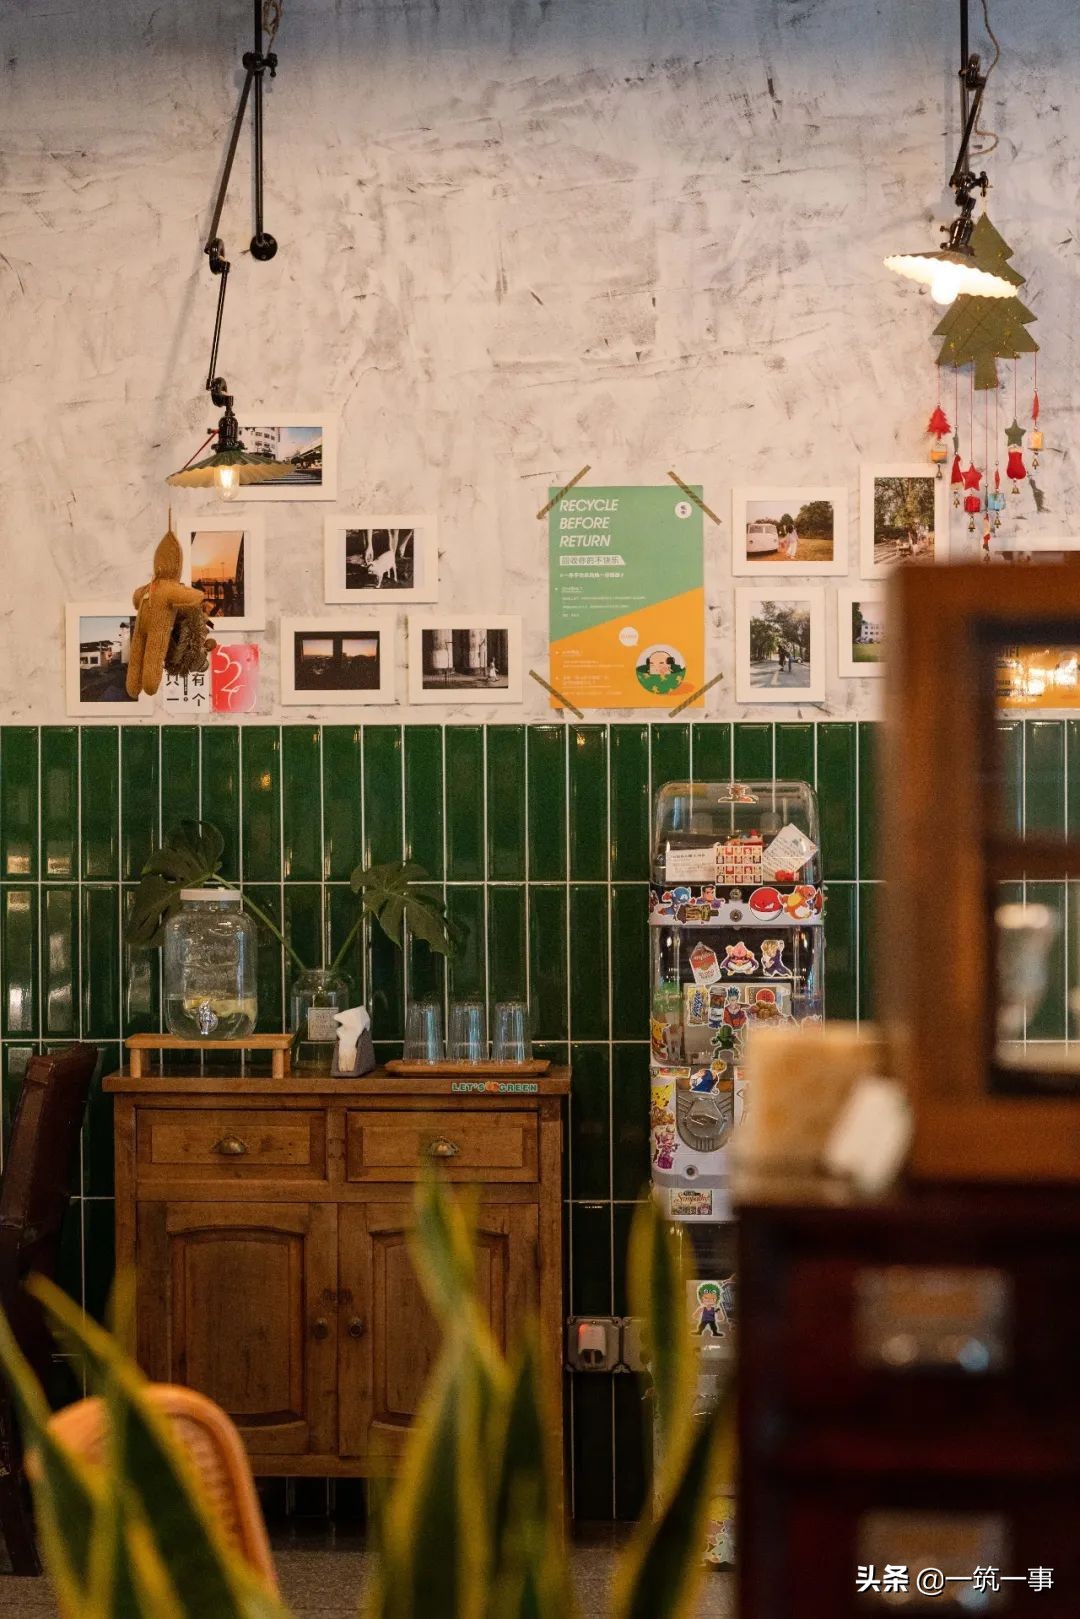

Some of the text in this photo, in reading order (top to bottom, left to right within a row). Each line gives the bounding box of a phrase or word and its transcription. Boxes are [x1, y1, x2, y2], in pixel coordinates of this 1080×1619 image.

[559, 498, 619, 512] RECYCLE
[559, 517, 611, 530] BEFORE
[559, 534, 612, 548] RETURN
[498, 1083, 539, 1093] GREEN
